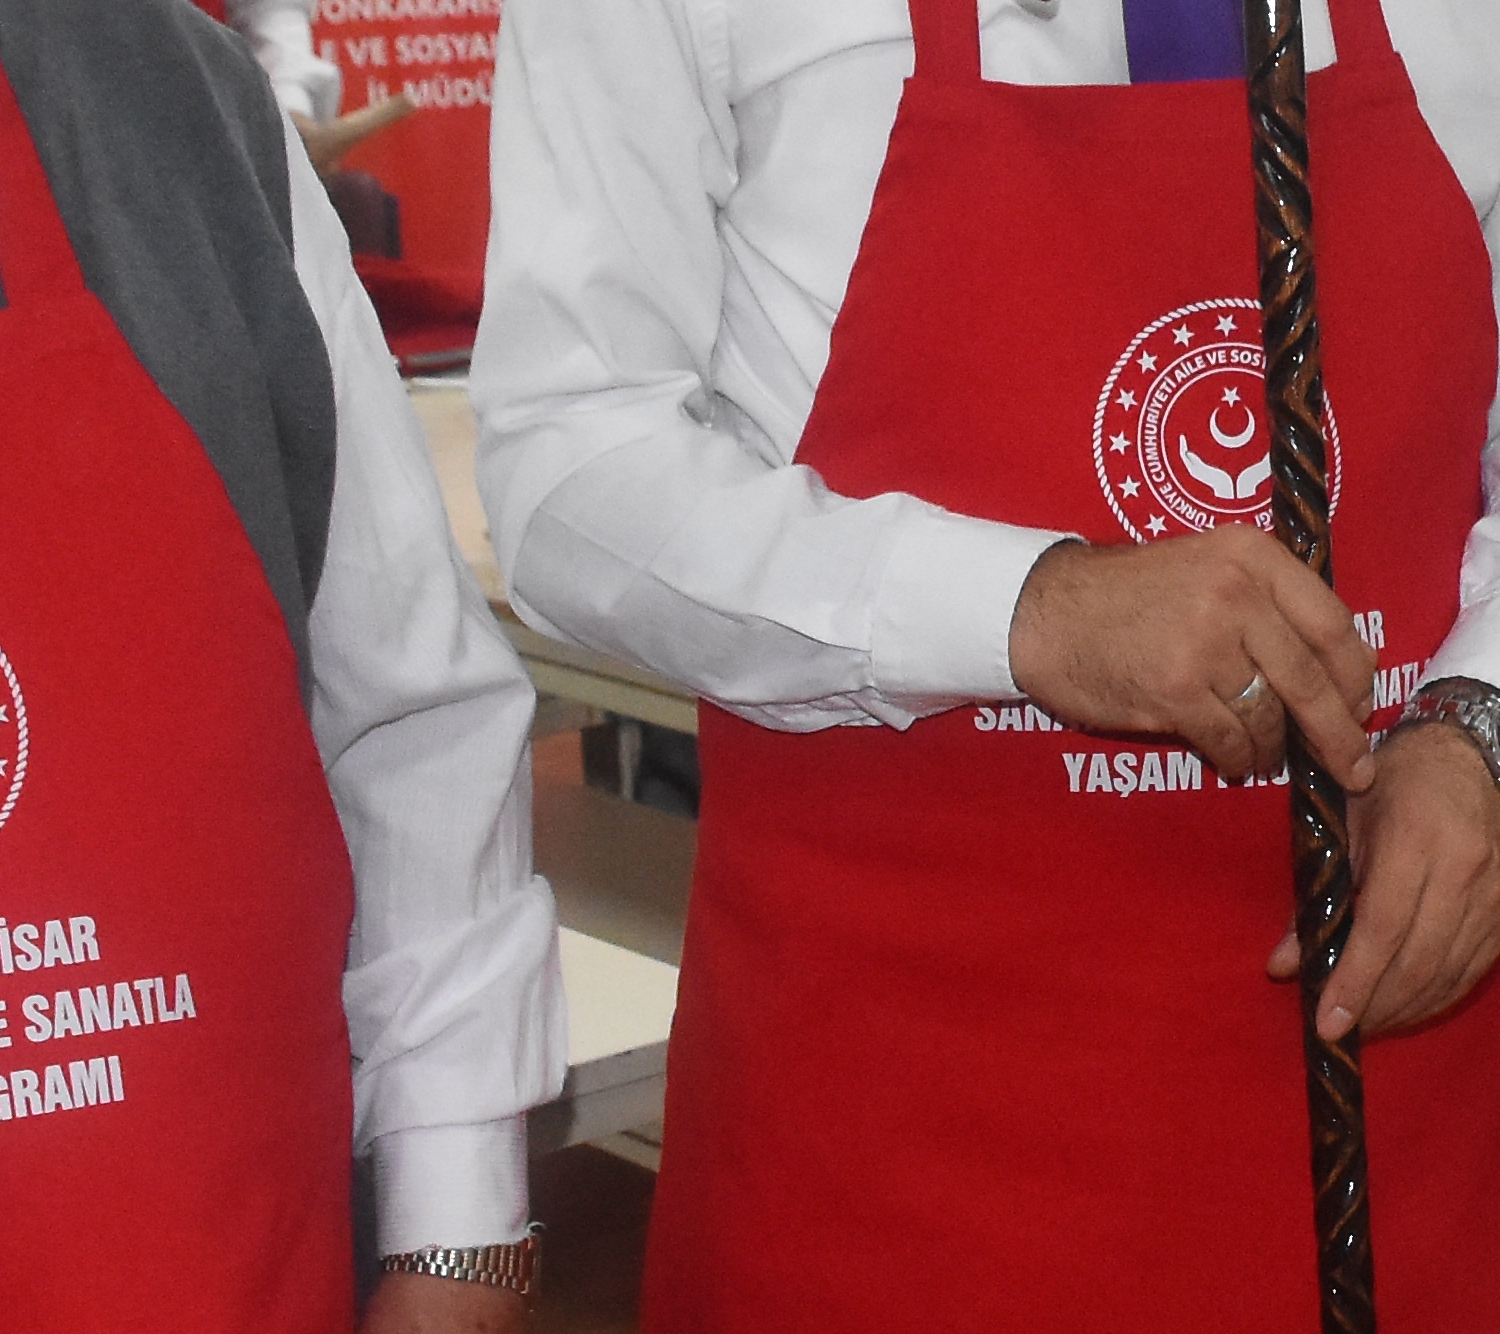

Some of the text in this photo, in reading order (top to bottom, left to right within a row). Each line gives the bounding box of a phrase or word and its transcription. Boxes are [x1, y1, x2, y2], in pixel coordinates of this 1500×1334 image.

[345, 36, 388, 66] VE
[1174, 356, 1206, 383] AİLE
[1206, 350, 1227, 365] VE
[1145, 376, 1177, 482] CUMHURİYETİ
[1159, 484, 1216, 529] TÜRKİYE
[1062, 752, 1202, 798] YAŞAM
[22, 973, 197, 1043] SANATLA
